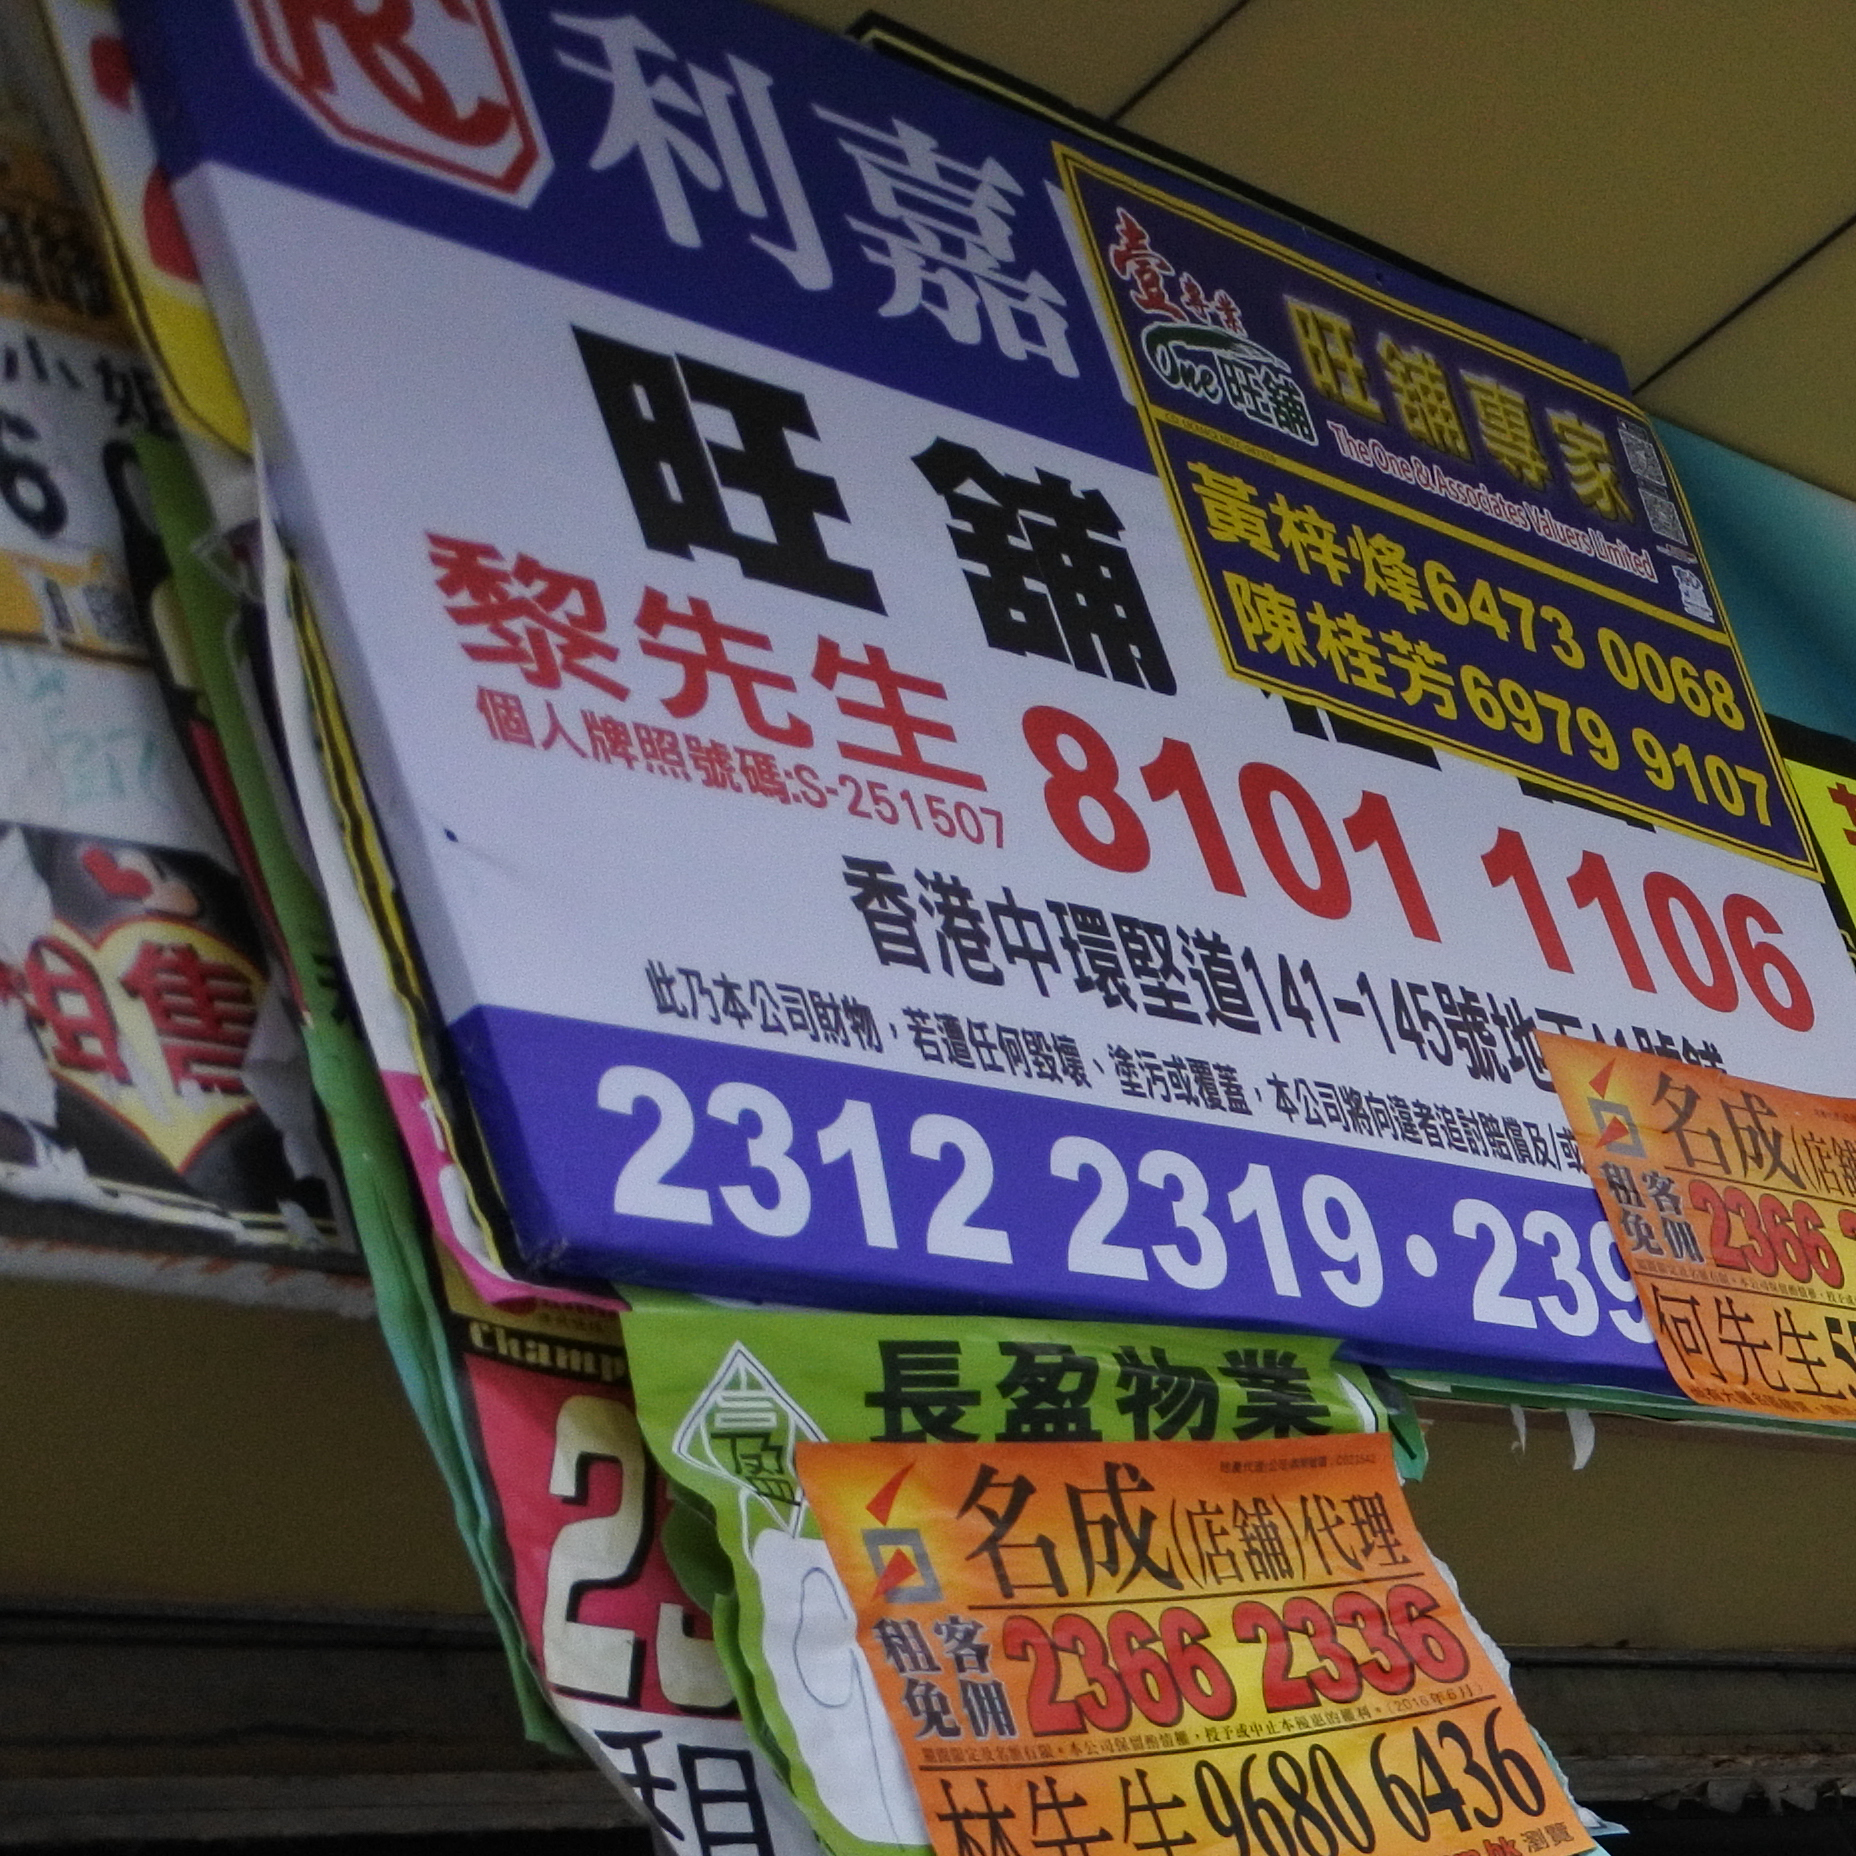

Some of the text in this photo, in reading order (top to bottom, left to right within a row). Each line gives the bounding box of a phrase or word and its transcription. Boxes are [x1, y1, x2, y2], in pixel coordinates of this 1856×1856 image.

[550, 12, 1135, 408] 利嘉
[1284, 295, 1637, 525] 旺舖專家
[1327, 419, 1373, 467] The
[1373, 439, 1415, 485] One
[1411, 456, 1437, 490] &
[1433, 464, 1530, 532] Associates
[1523, 501, 1594, 557] Valuers
[1590, 528, 1658, 583] Limited
[425, 530, 987, 792] 黎先生
[1598, 627, 1746, 728] 0068
[1633, 728, 1772, 828] 9107
[1021, 704, 1441, 944] 8101
[1480, 825, 1814, 1034] 1106
[597, 1064, 1013, 1266] 2312
[1687, 1179, 1845, 1290] 2366
[865, 1338, 1332, 1445] 長盈物業
[957, 1460, 1407, 1603] 名成(店舖)代理
[873, 1616, 995, 1677] 租客
[901, 1676, 1020, 1741] 免佣
[1003, 1606, 1238, 1738] 2366
[1233, 1584, 1472, 1714] 2336
[1372, 1710, 1547, 1844] 6436
